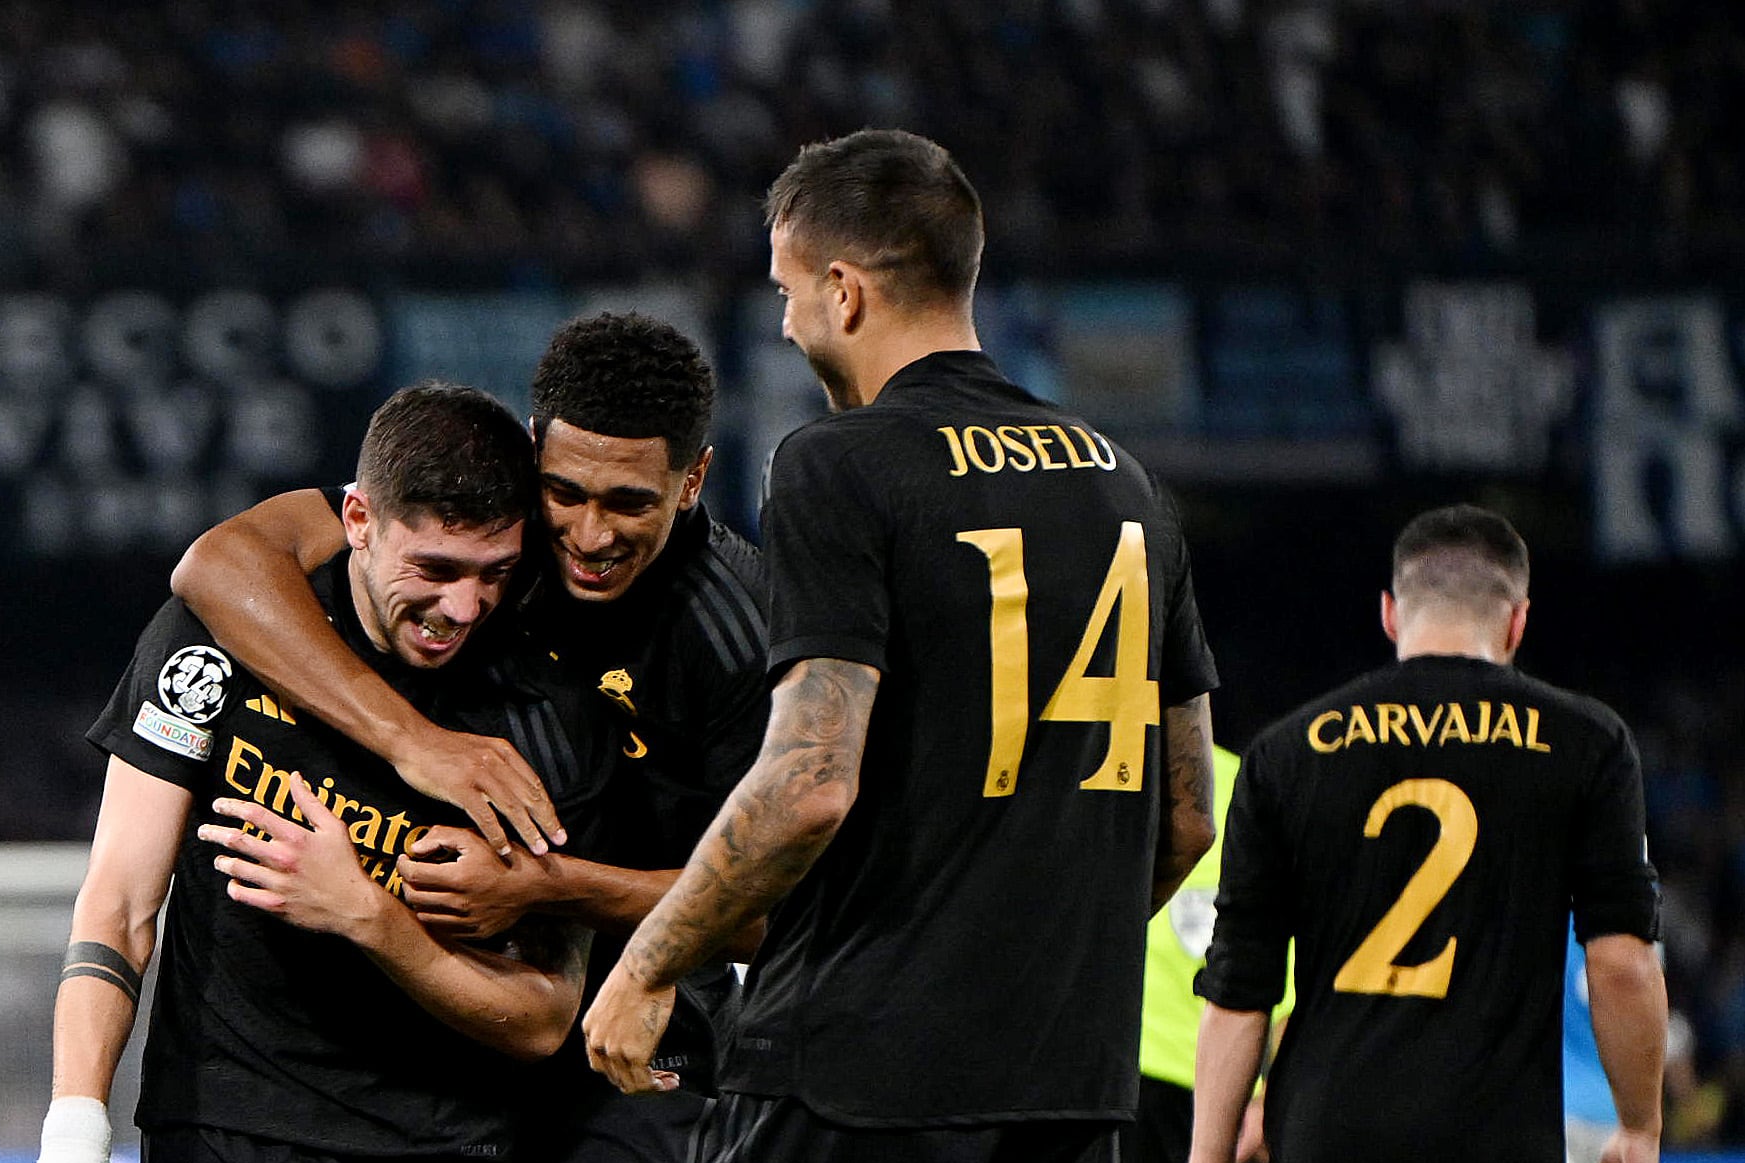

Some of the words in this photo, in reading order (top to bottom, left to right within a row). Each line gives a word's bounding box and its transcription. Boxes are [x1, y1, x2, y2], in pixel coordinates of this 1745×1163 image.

[936, 425, 1117, 477] JOSELU
[175, 664, 214, 704] 14
[955, 521, 1161, 798] 14
[1307, 701, 1552, 754] CARVAJAL
[1333, 778, 1478, 999] 2
